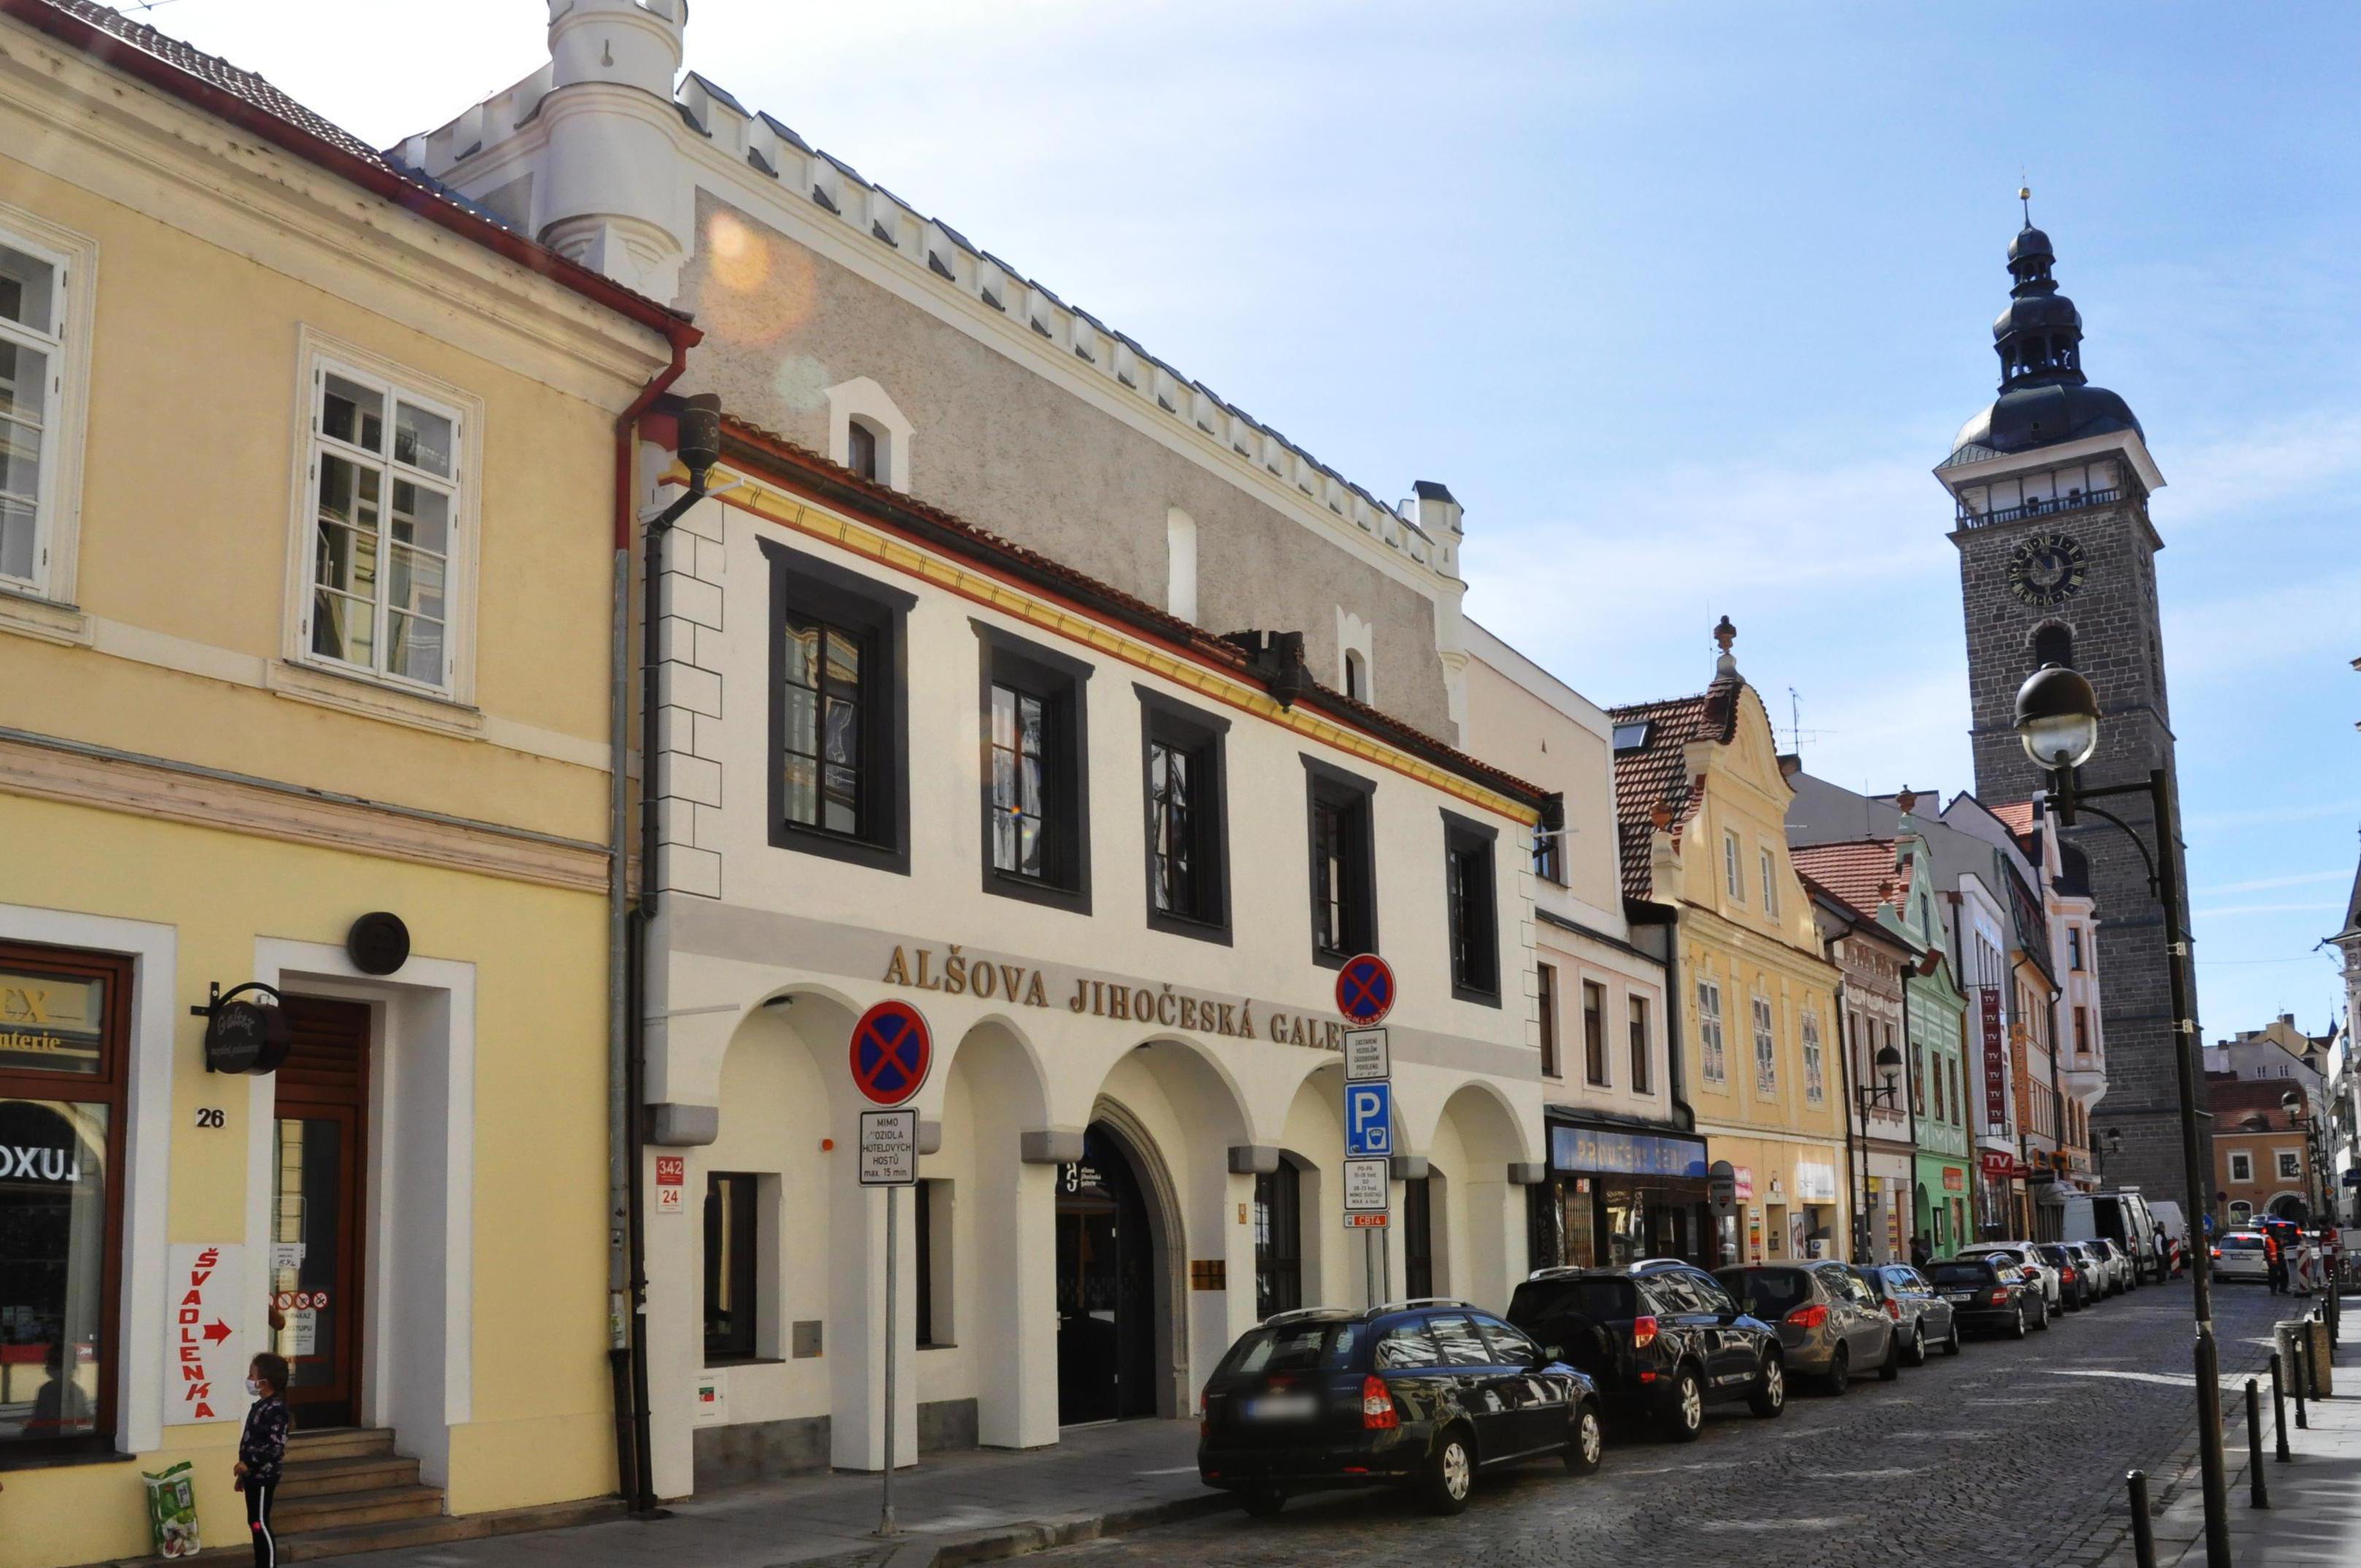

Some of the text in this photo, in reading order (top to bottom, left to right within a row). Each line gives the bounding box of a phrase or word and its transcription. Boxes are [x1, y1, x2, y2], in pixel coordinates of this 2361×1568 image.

[883, 944, 1050, 1007] ALŠOVA
[1070, 978, 1257, 1039] JIHOČESKÁ
[196, 1107, 225, 1128] 26
[1355, 1092, 1381, 1133] P
[876, 1118, 898, 1126] MIMO
[871, 1131, 903, 1140] OZIDLA
[863, 1143, 911, 1152] HOTELOVÝCH
[873, 1153, 898, 1165] HOSTŮ
[1985, 1154, 2010, 1166] TV
[659, 1161, 682, 1174] 342
[884, 1168, 891, 1177] 15
[663, 1190, 678, 1203] 24
[1359, 1217, 1381, 1225] CBT4
[179, 1247, 219, 1419] ŠVADLENKA
